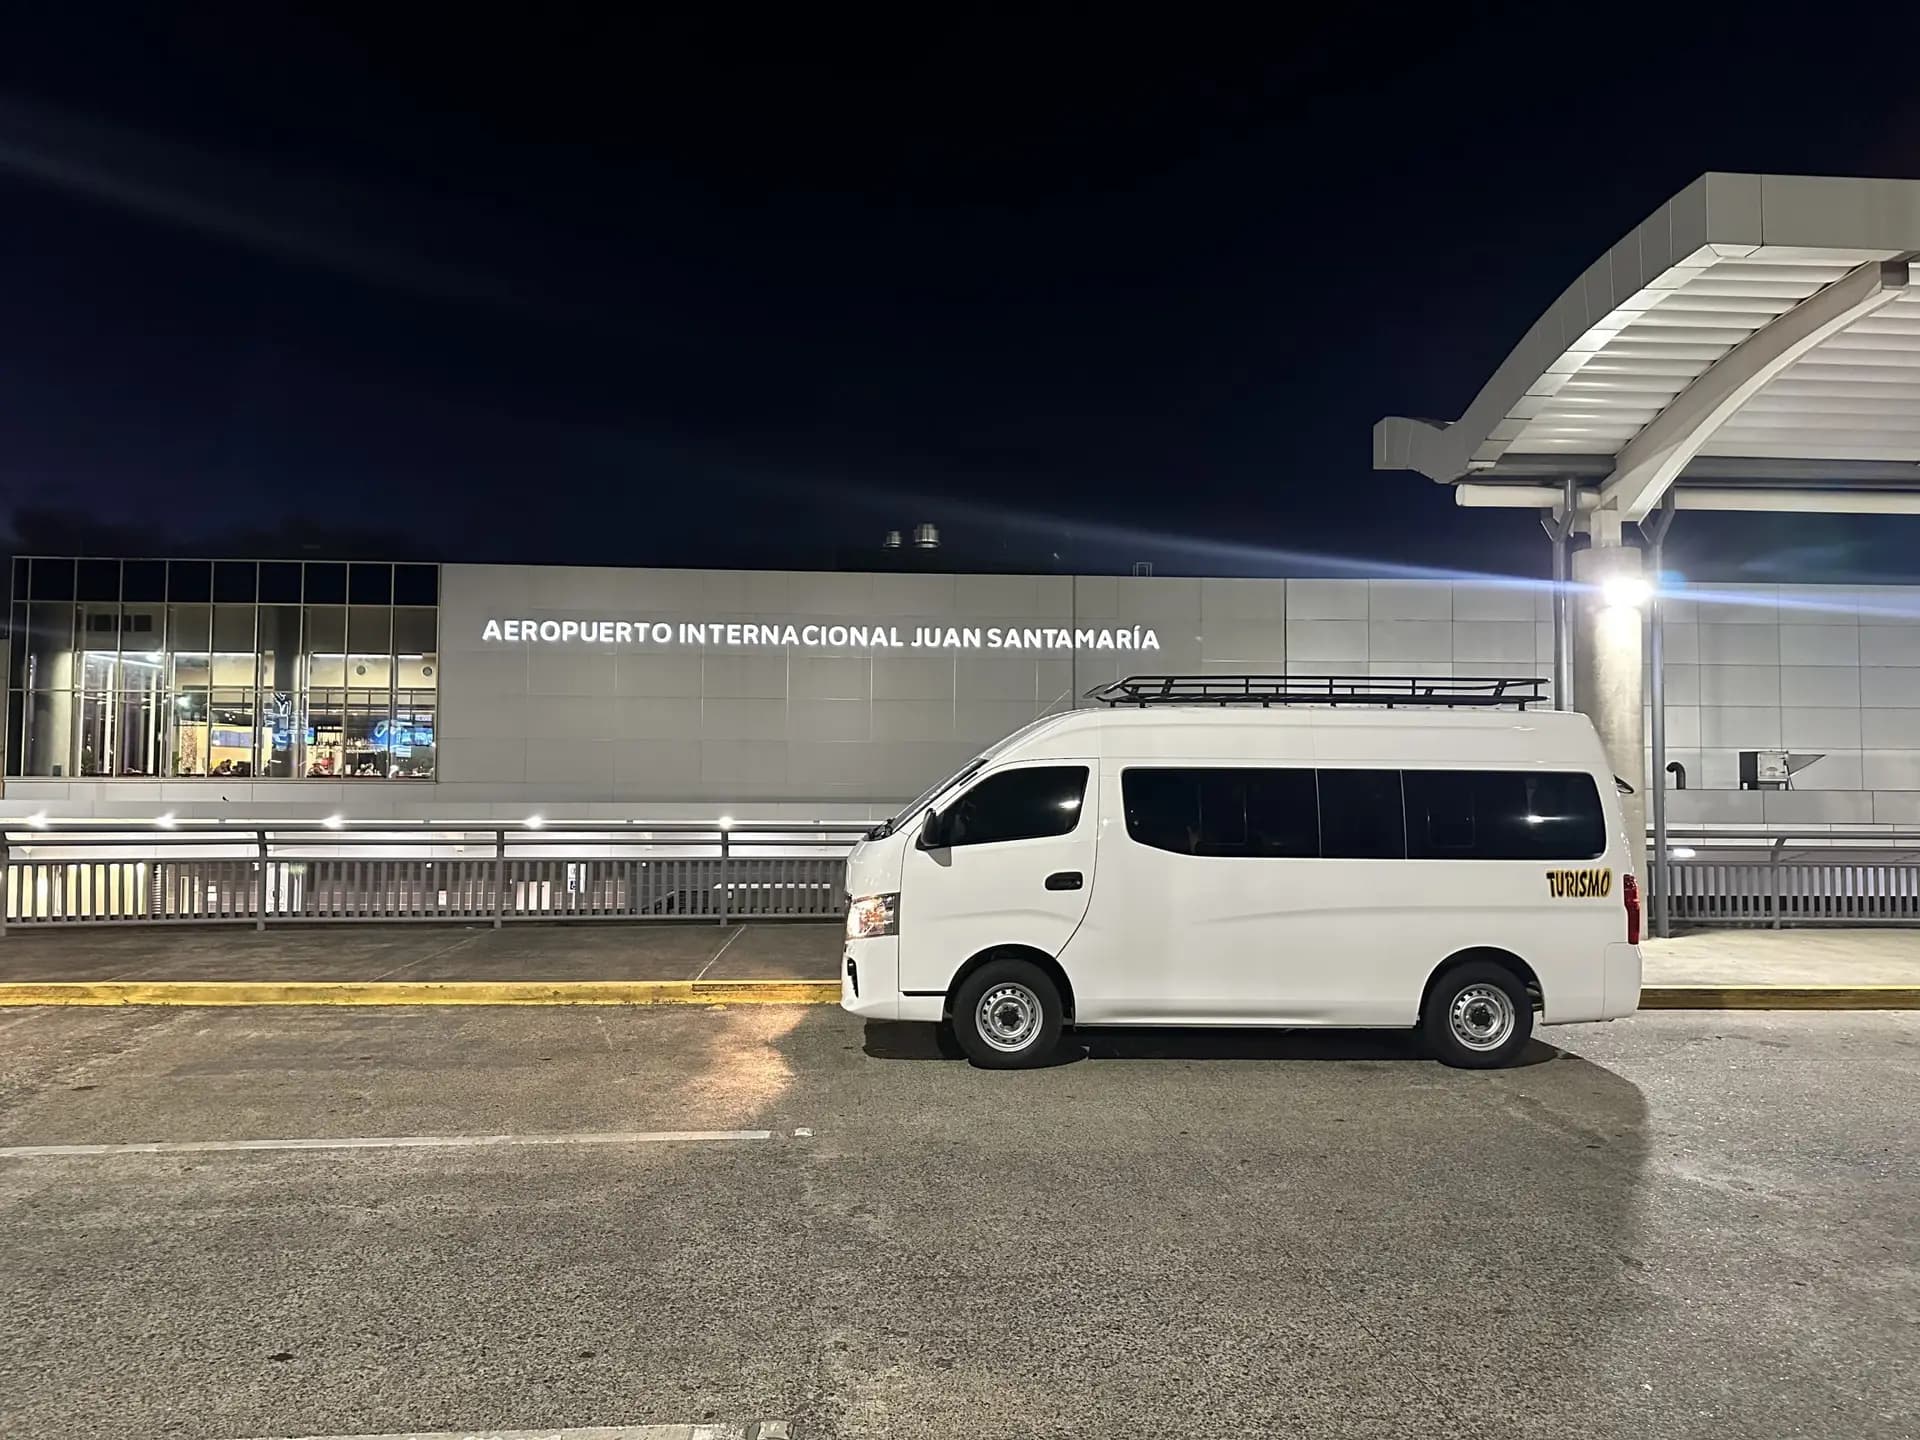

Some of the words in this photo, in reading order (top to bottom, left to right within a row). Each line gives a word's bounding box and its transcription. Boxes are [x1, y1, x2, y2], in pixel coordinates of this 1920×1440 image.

[482, 619, 672, 644] AEROPUERTO
[679, 623, 903, 647] INTERNACIONAL
[911, 627, 981, 648] JUAN
[987, 625, 1160, 649] SANTAMARÍA
[1546, 868, 1612, 898] TURISMO
